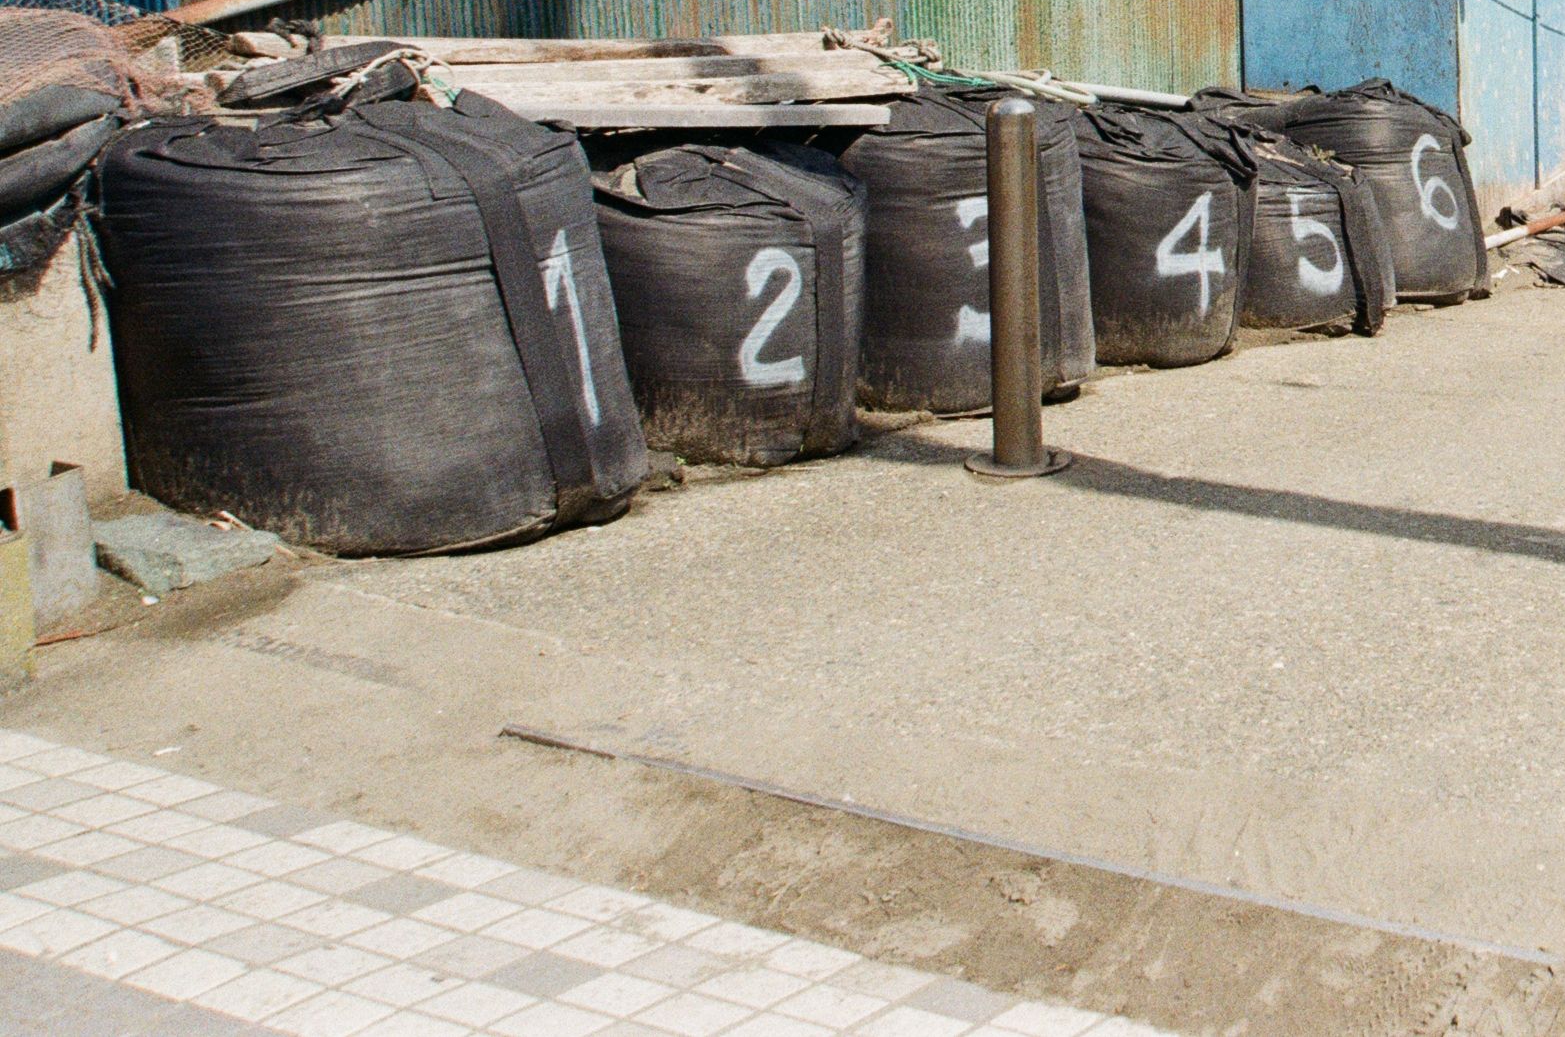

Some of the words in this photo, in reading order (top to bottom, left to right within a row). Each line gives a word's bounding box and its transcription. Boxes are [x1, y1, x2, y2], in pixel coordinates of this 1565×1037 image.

[1286, 187, 1343, 295] 5
[1411, 133, 1458, 229] 6
[739, 247, 804, 383] 2
[1156, 191, 1224, 318] 4
[538, 228, 600, 426] 1
